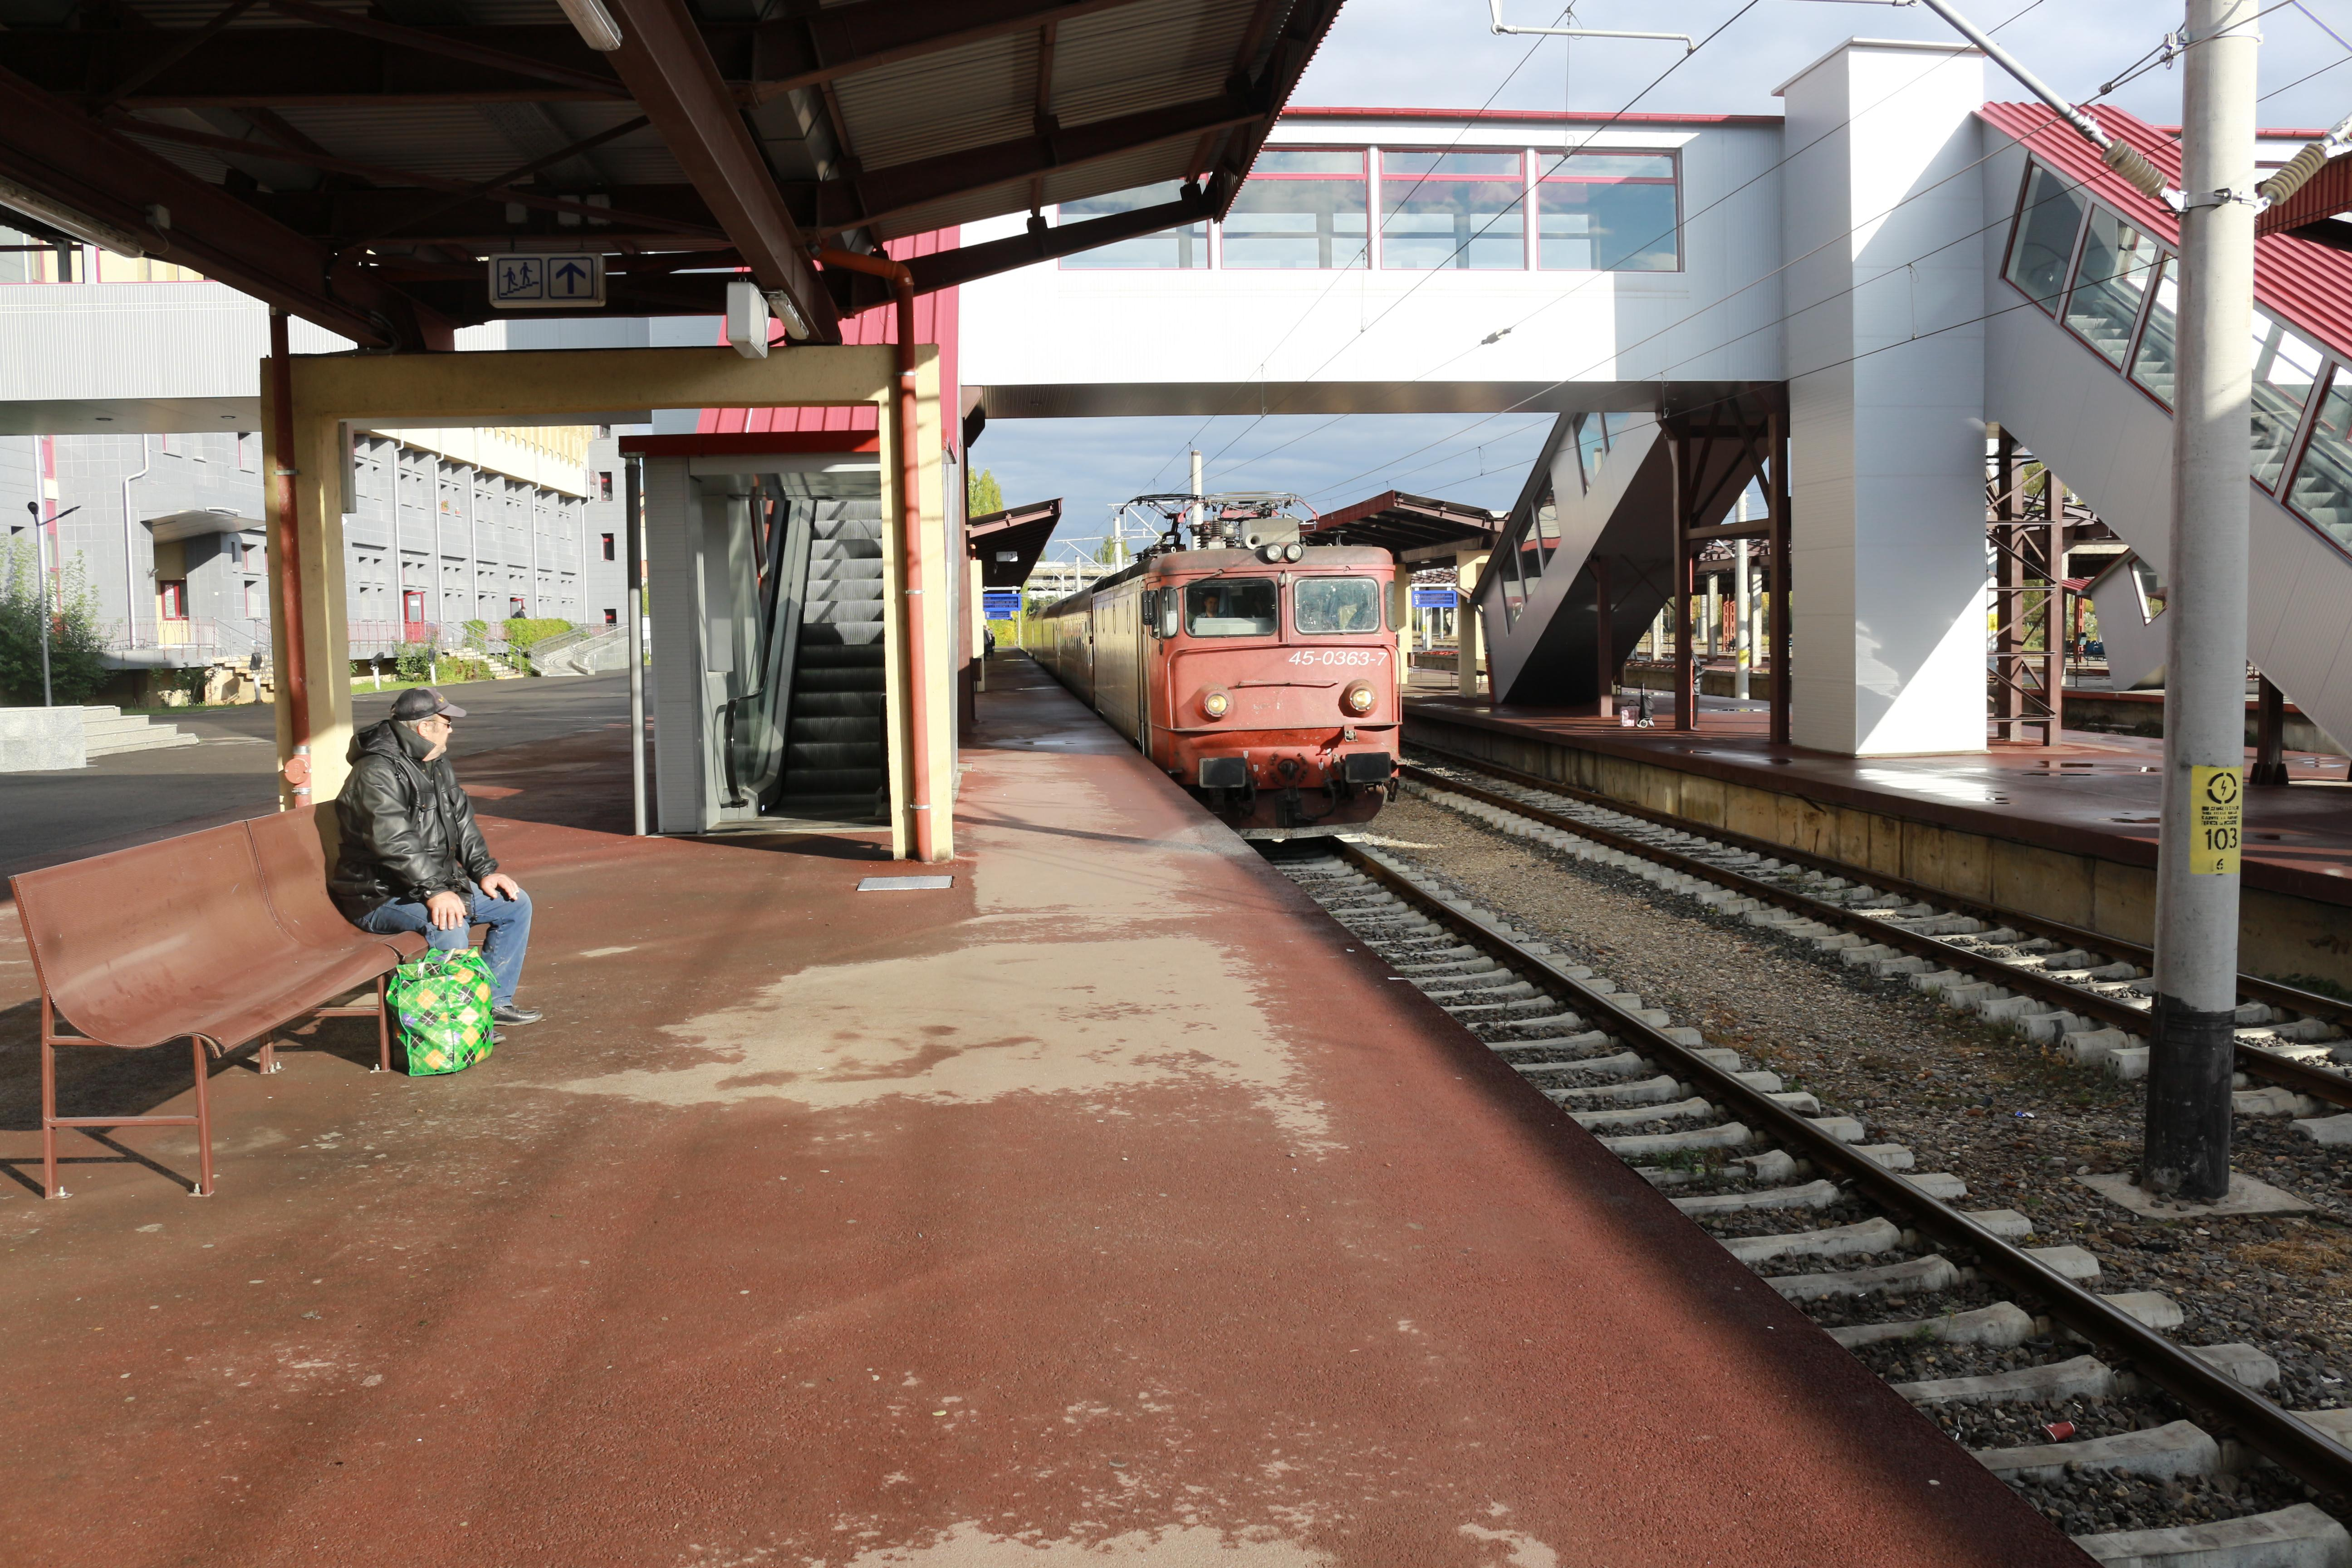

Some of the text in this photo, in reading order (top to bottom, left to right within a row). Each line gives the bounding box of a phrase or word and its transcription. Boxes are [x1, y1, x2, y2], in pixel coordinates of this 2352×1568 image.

[1289, 651, 1387, 666] 45-0363-7
[2205, 828, 2237, 850] 103
[2216, 858, 2223, 870] 6
